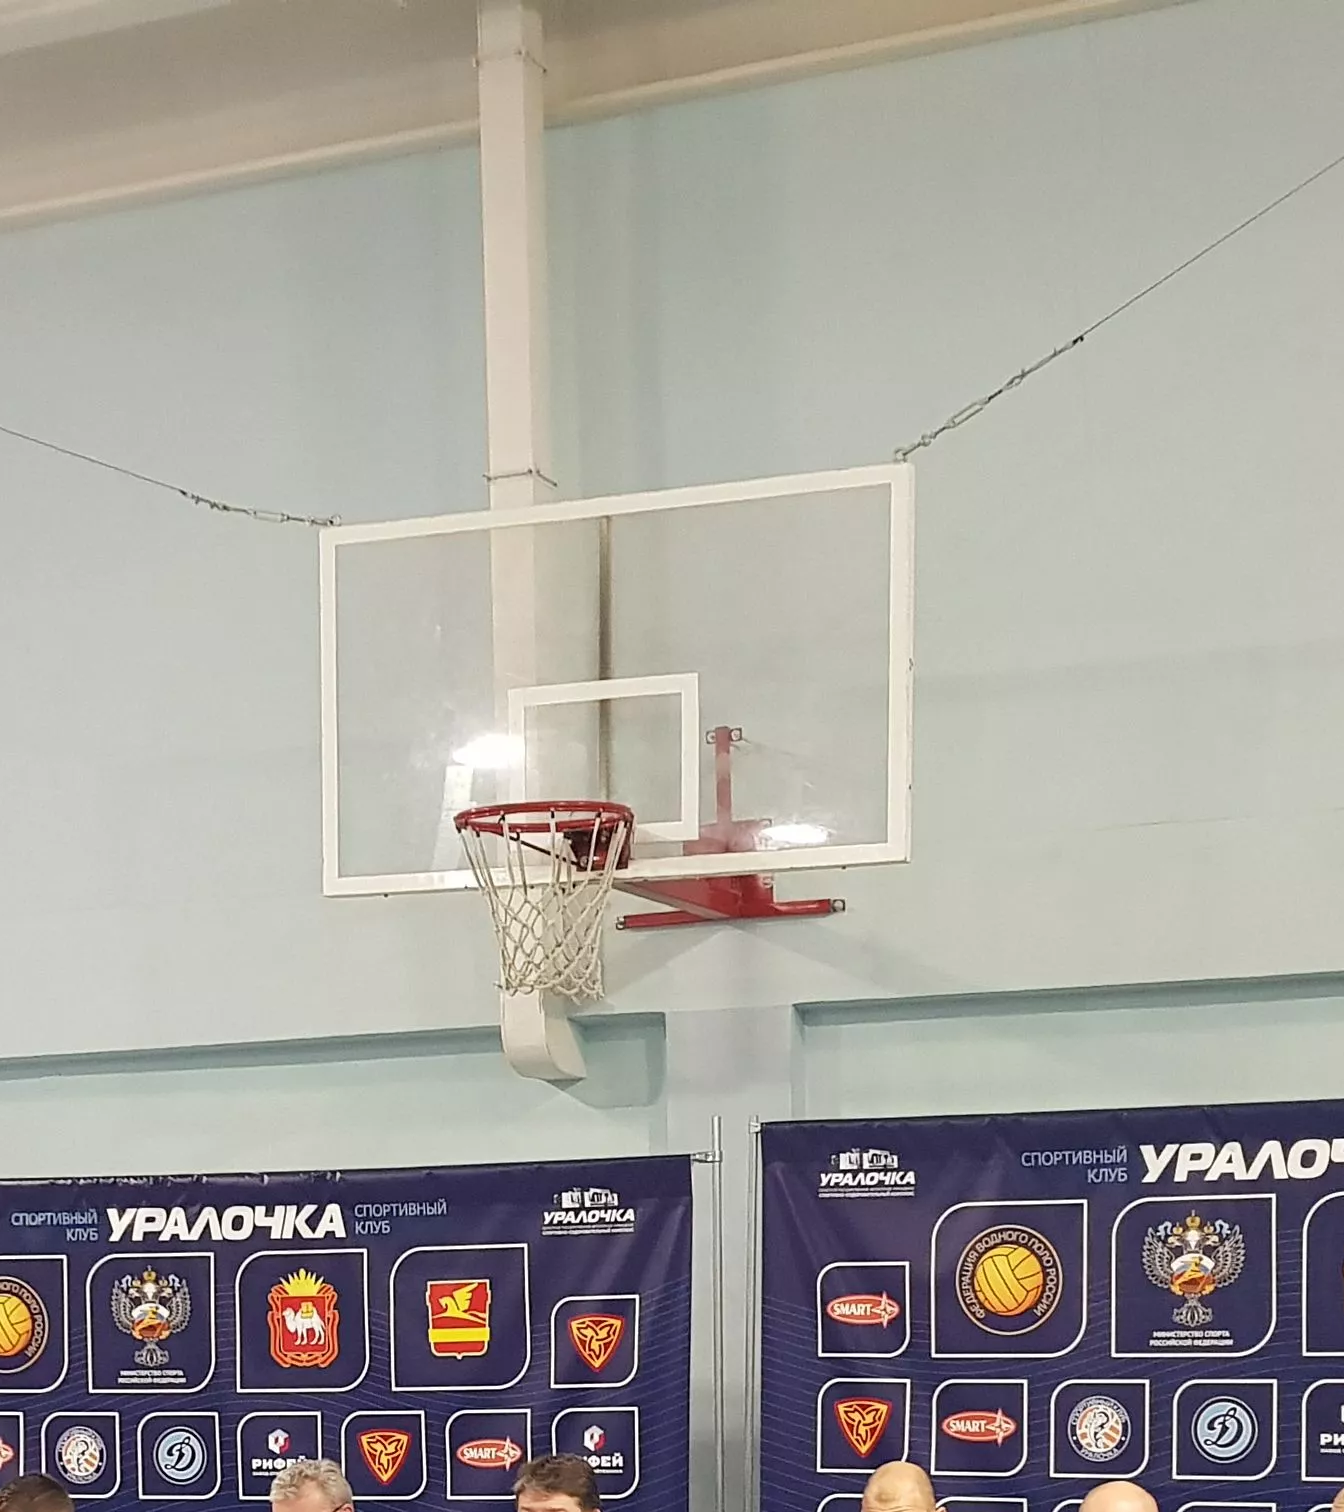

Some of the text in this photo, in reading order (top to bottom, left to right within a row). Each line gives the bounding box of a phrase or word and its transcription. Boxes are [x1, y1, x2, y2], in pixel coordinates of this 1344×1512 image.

[1021, 1146, 1127, 1167] СПОРТИВНЫЙ
[819, 1171, 916, 1187] УРАЛОЧКА
[1087, 1168, 1128, 1184] КЛУБ
[355, 1199, 448, 1218] СПОРТИВНЫЙ
[543, 1208, 635, 1225] УРАЛОЧКА
[11, 1208, 99, 1227] СПОРТИВНЫЙ
[106, 1203, 347, 1242] УРАЛОЧКА
[66, 1228, 99, 1242] КЛУБ
[355, 1221, 391, 1235] КЛУБ
[961, 1231, 1057, 1319] ФЕДЕРАЦИЯ ВОДНОГО ПОЛО РОССИИ
[18, 1288, 40, 1314] ПОЛО
[833, 1302, 872, 1316] SMART
[950, 1419, 987, 1433] SMART
[463, 1447, 498, 1460] SMART
[583, 1452, 623, 1468] ФЕЙ
